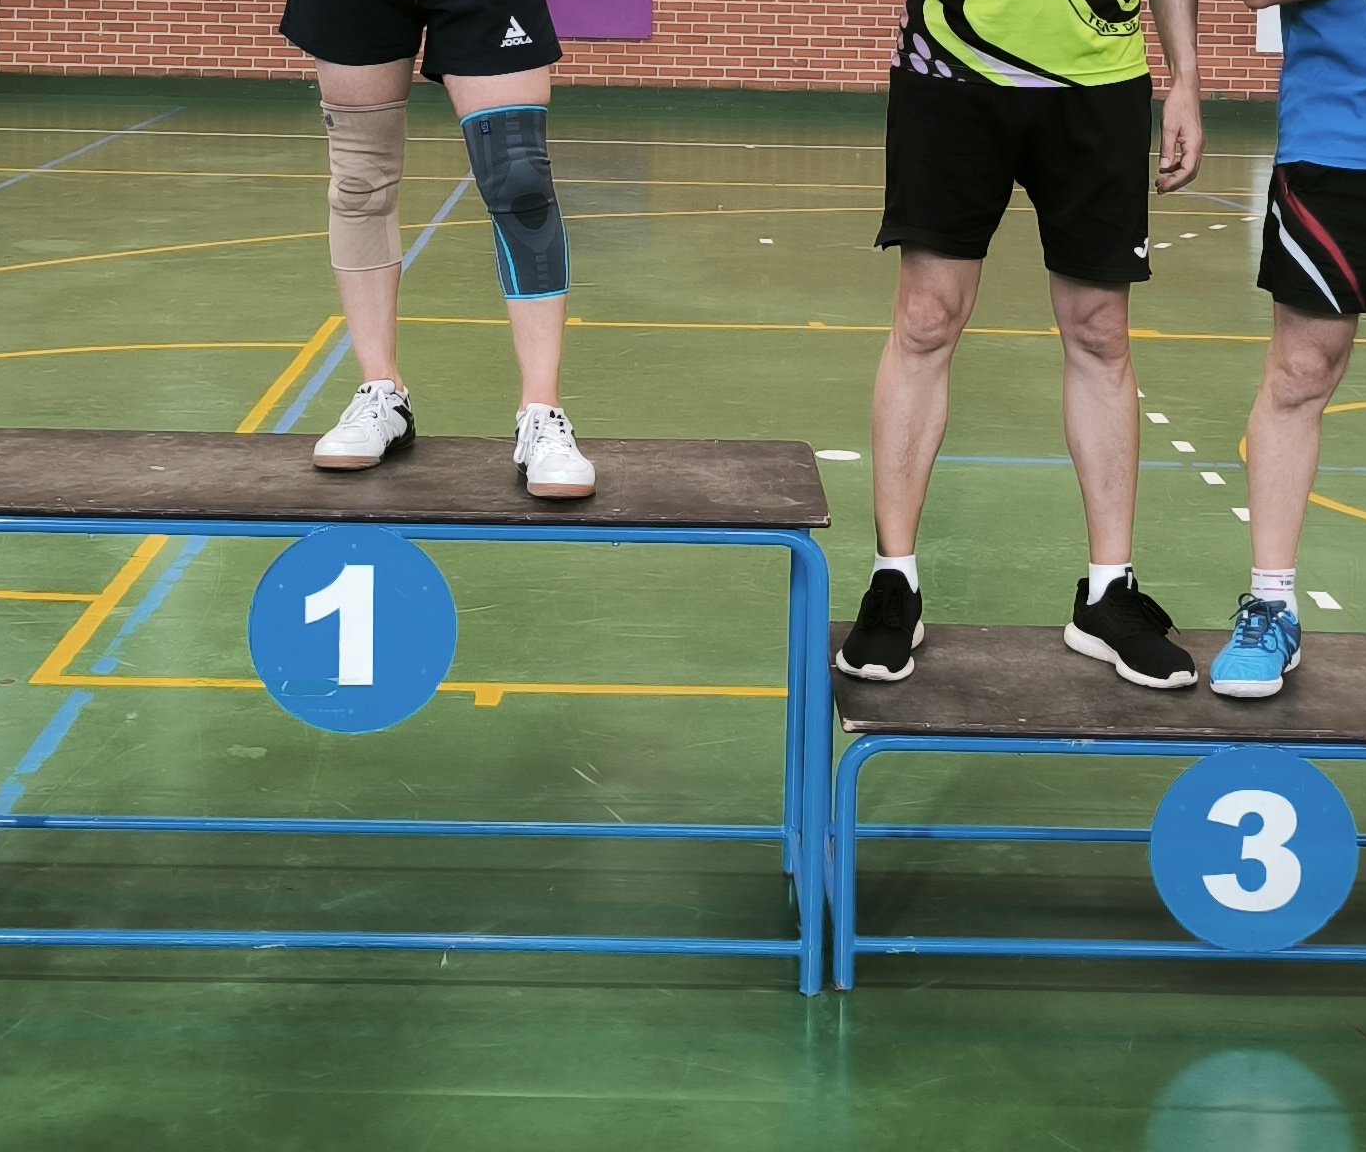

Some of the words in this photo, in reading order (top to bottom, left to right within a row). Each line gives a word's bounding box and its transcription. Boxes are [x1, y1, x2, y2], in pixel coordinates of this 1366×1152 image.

[500, 36, 534, 48] JOOLA
[303, 563, 376, 686] 1
[1202, 789, 1302, 913] 3
